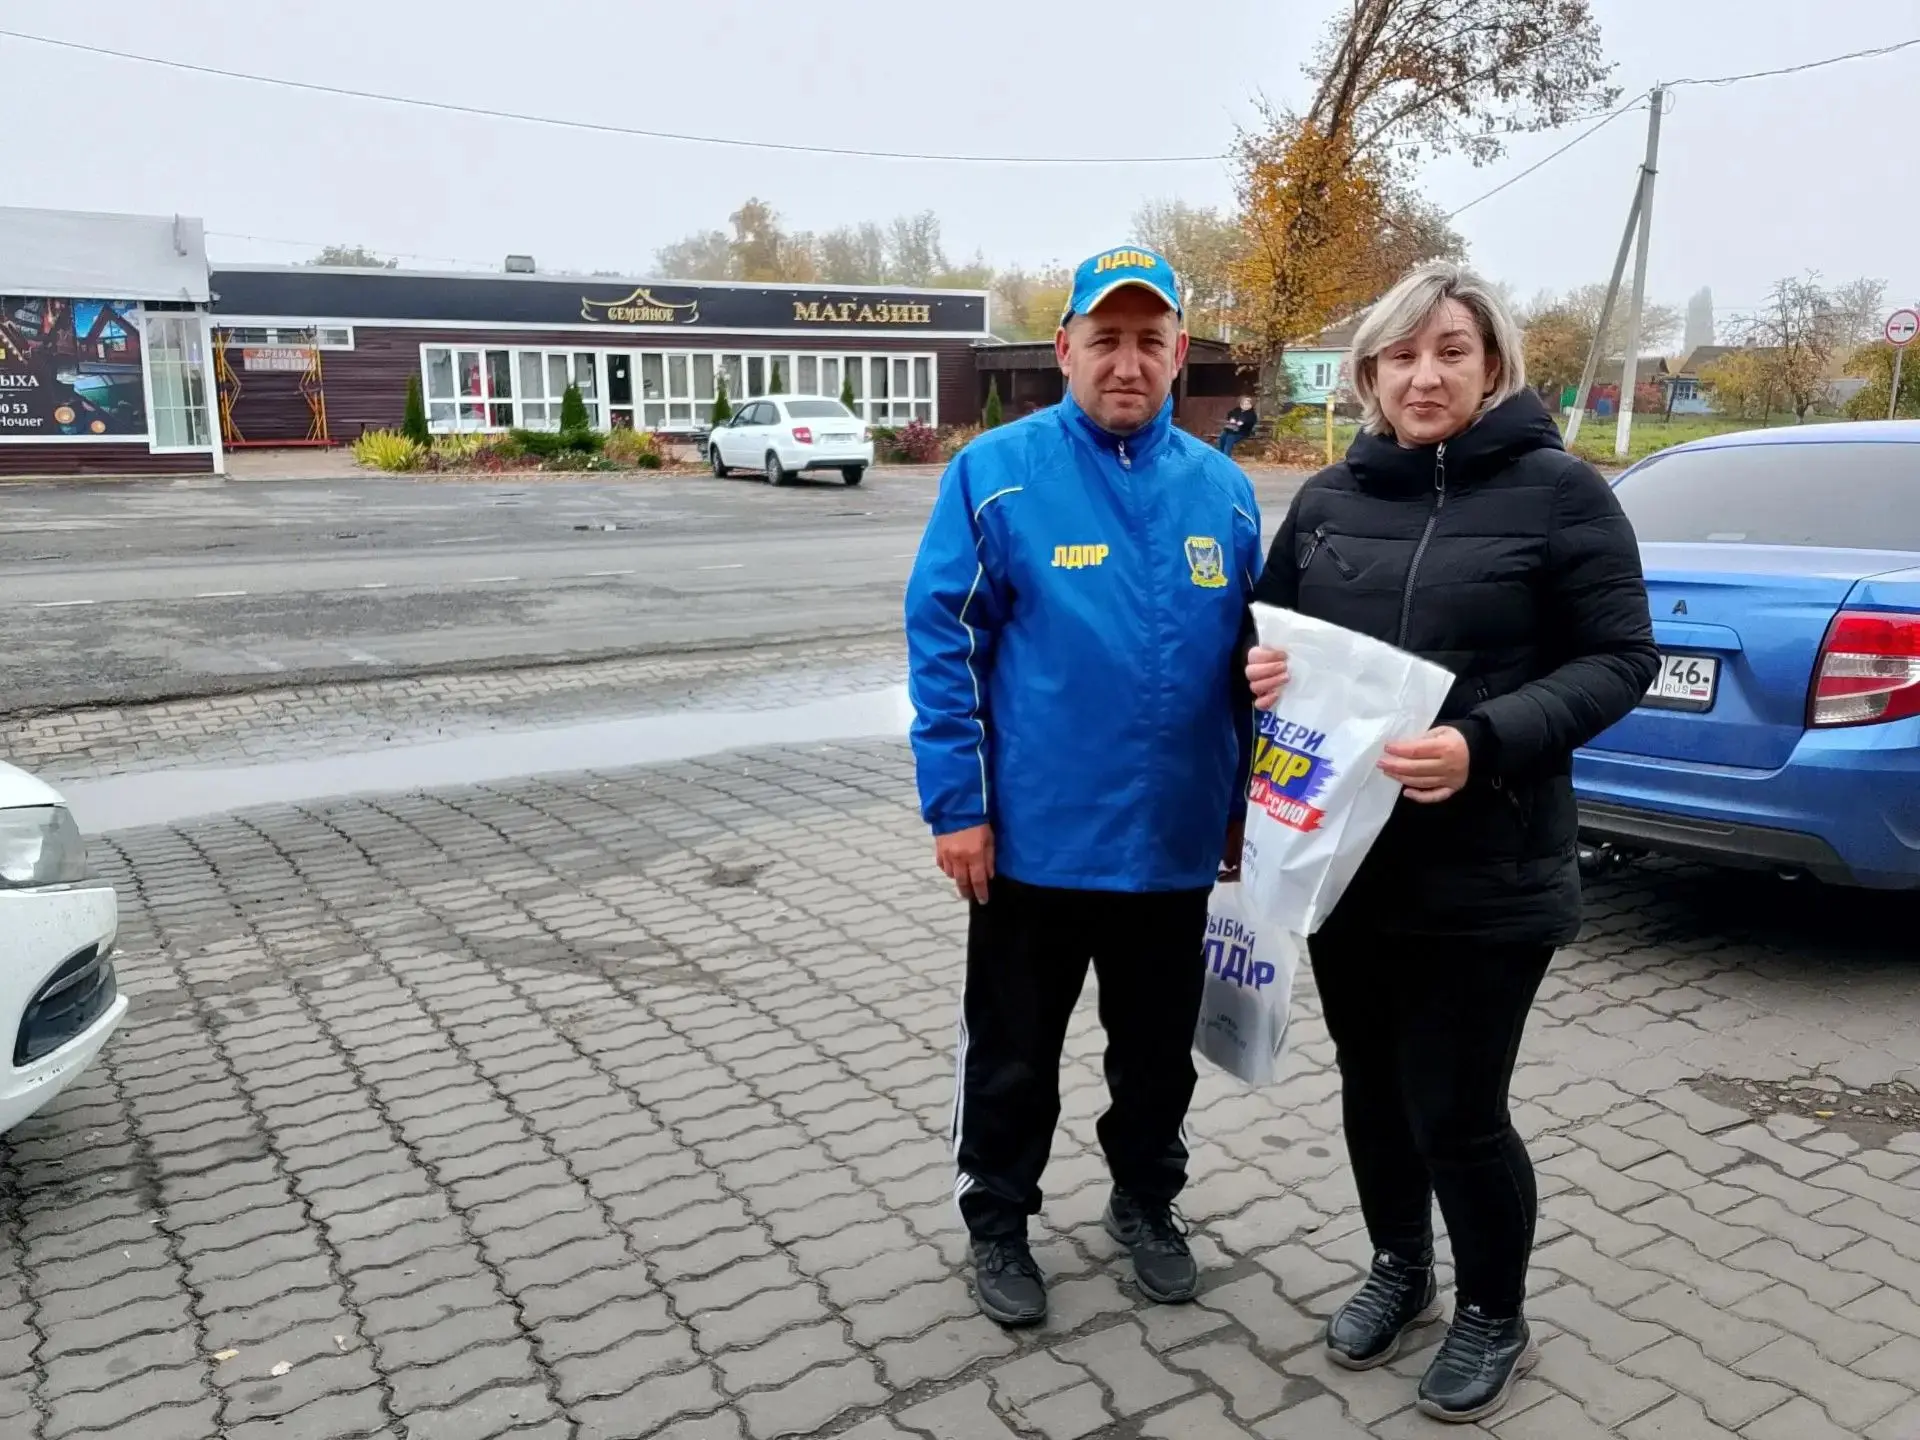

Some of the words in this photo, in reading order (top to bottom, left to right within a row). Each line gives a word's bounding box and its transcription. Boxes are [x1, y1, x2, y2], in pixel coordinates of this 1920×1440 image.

[1094, 250, 1156, 274] ЛДПР
[607, 306, 675, 323] СЕМЕЙНОЕ
[793, 301, 931, 323] МАГАЗИН
[13, 403, 28, 414] 53
[0, 415, 43, 427] Ночлег
[1051, 544, 1109, 569] ЛДПР
[1669, 659, 1701, 685] 46
[1664, 683, 1688, 694] RUS
